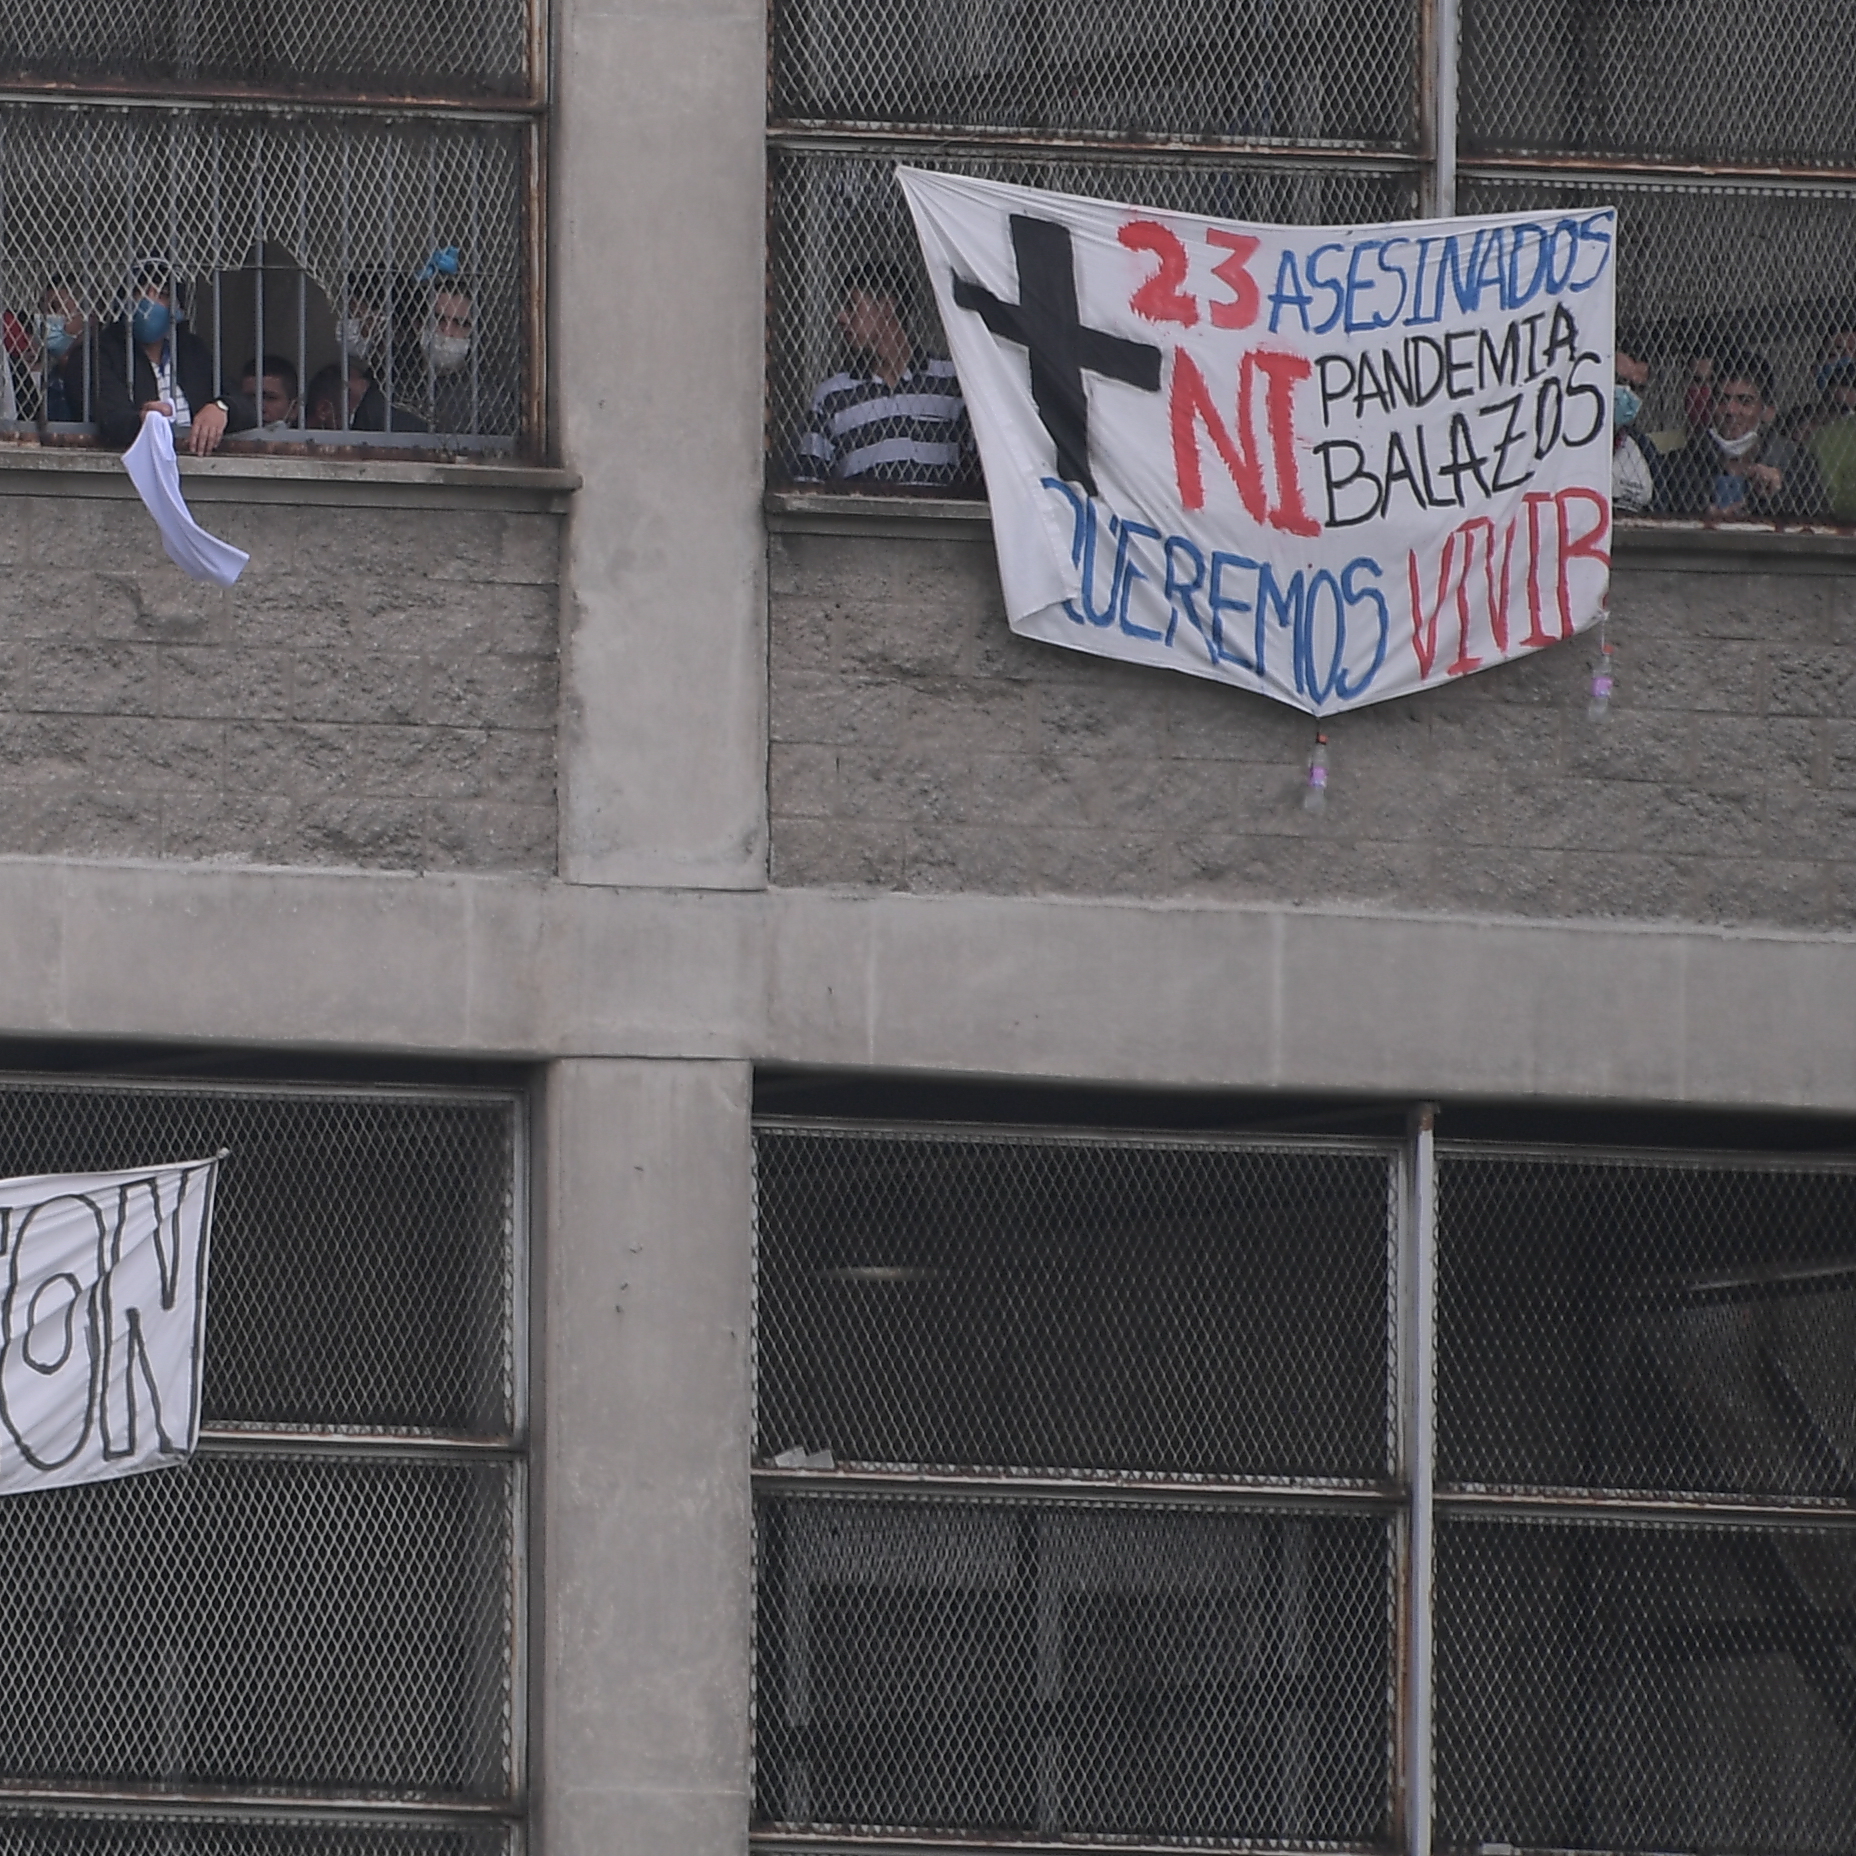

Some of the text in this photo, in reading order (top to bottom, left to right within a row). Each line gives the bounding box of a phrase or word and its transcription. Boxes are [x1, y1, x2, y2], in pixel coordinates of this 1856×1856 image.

[1116, 209, 1616, 334] 23 ASESINADOS
[1167, 302, 1578, 538] NI PANDEMIA
[1311, 352, 1606, 529] BALAZOS
[1409, 486, 1612, 683] VIVIR
